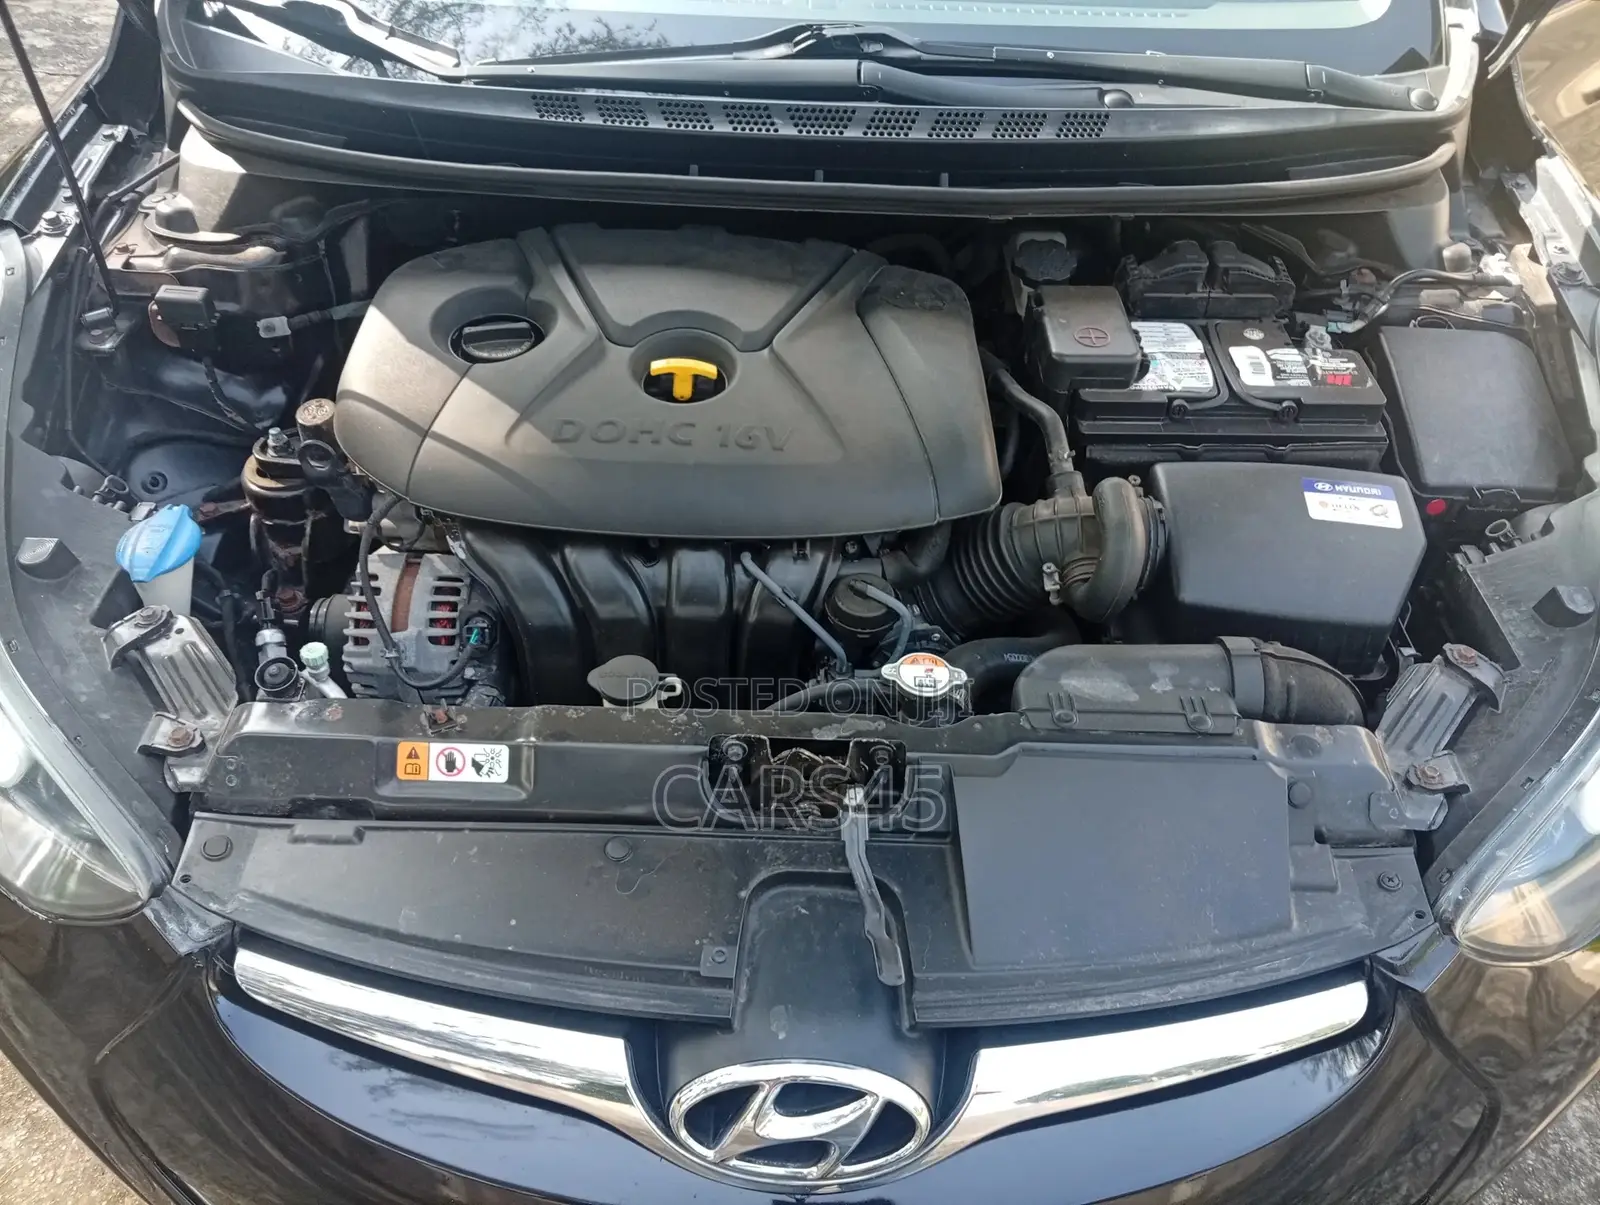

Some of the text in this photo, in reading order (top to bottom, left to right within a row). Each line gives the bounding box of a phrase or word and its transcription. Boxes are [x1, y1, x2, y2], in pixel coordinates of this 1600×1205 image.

[550, 417, 796, 452] DOHC 16V
[1334, 484, 1383, 496] HYUNDAI
